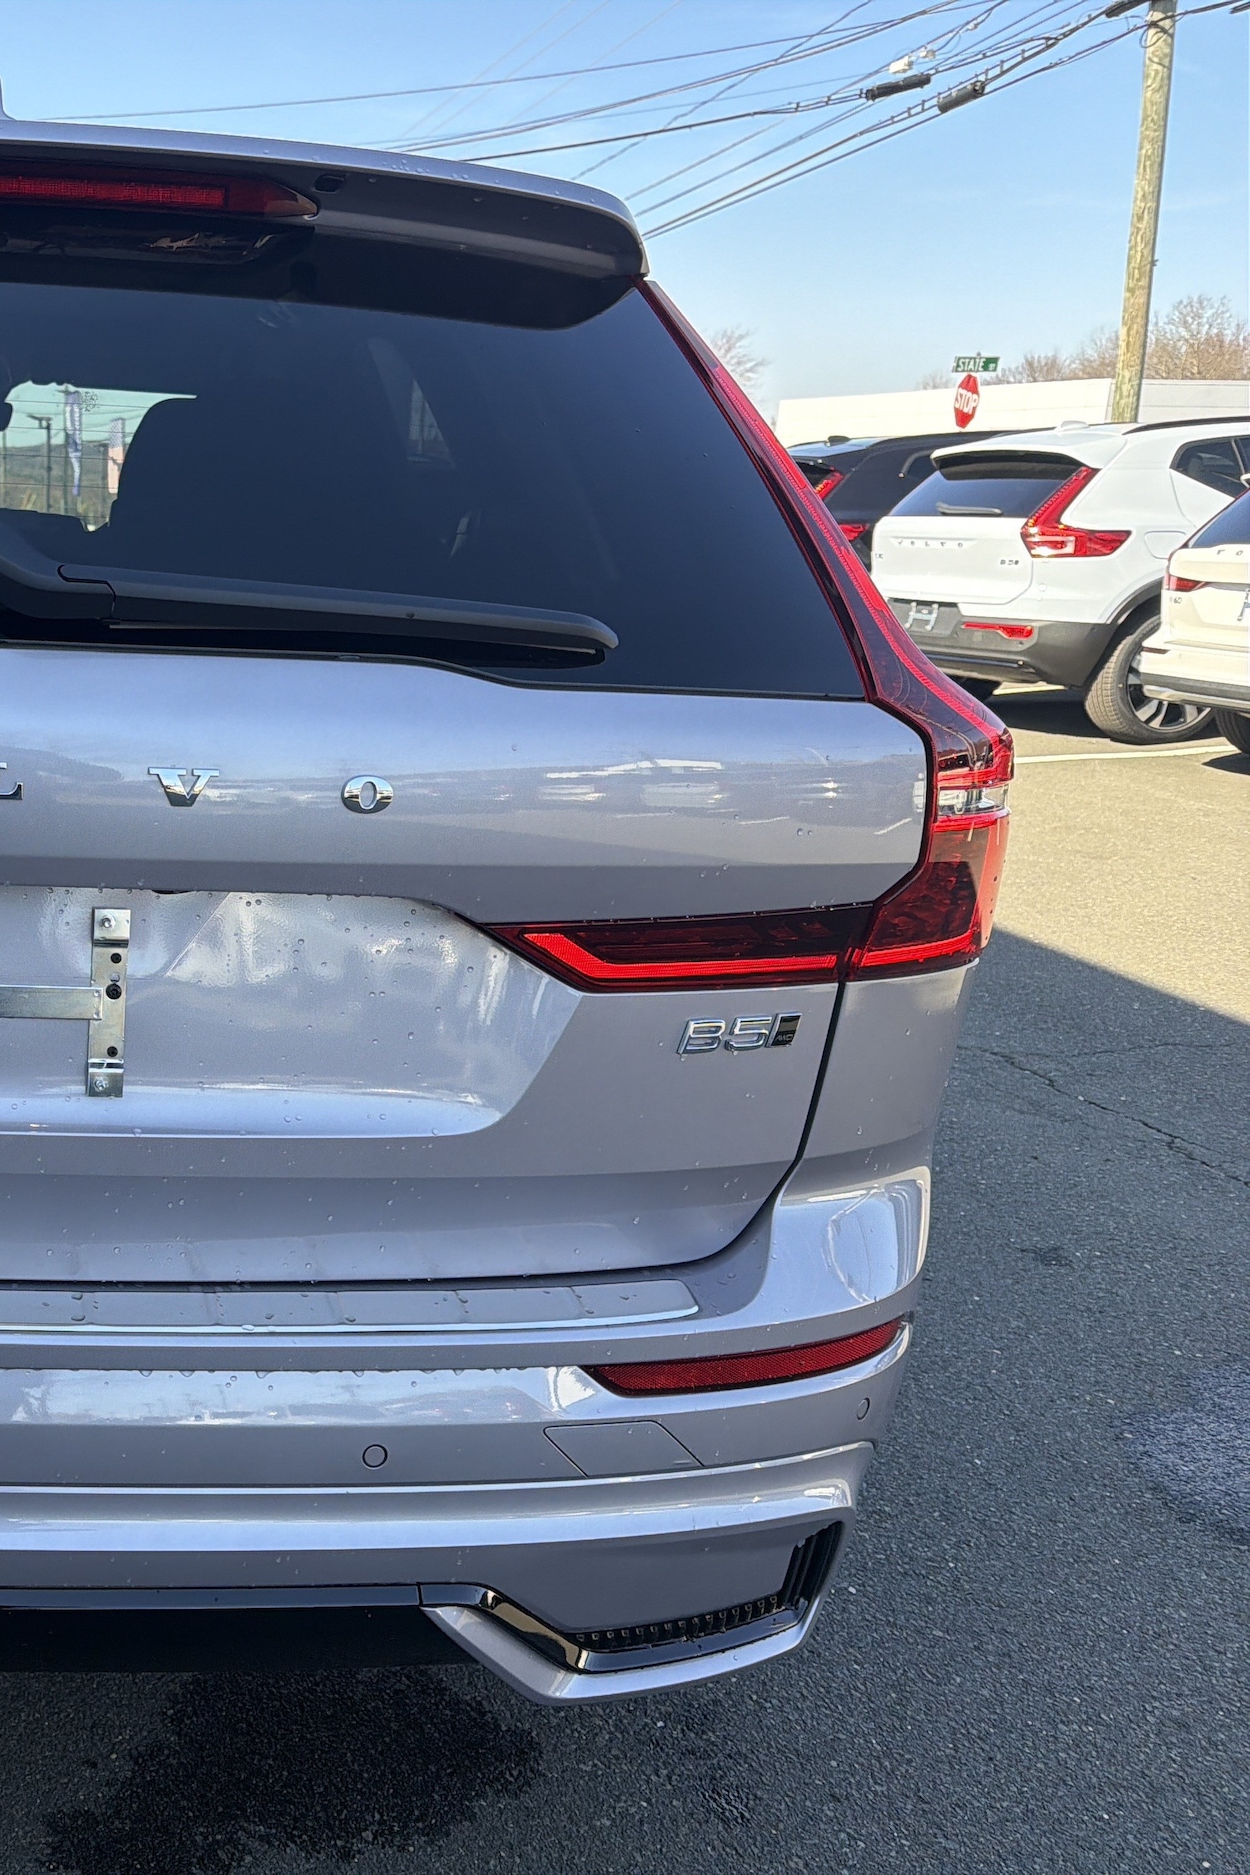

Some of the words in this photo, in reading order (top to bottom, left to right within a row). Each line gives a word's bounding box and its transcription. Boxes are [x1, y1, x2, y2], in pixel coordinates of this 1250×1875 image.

[957, 358, 987, 372] STATE
[954, 387, 979, 415] STOP
[676, 1016, 772, 1054] B5
